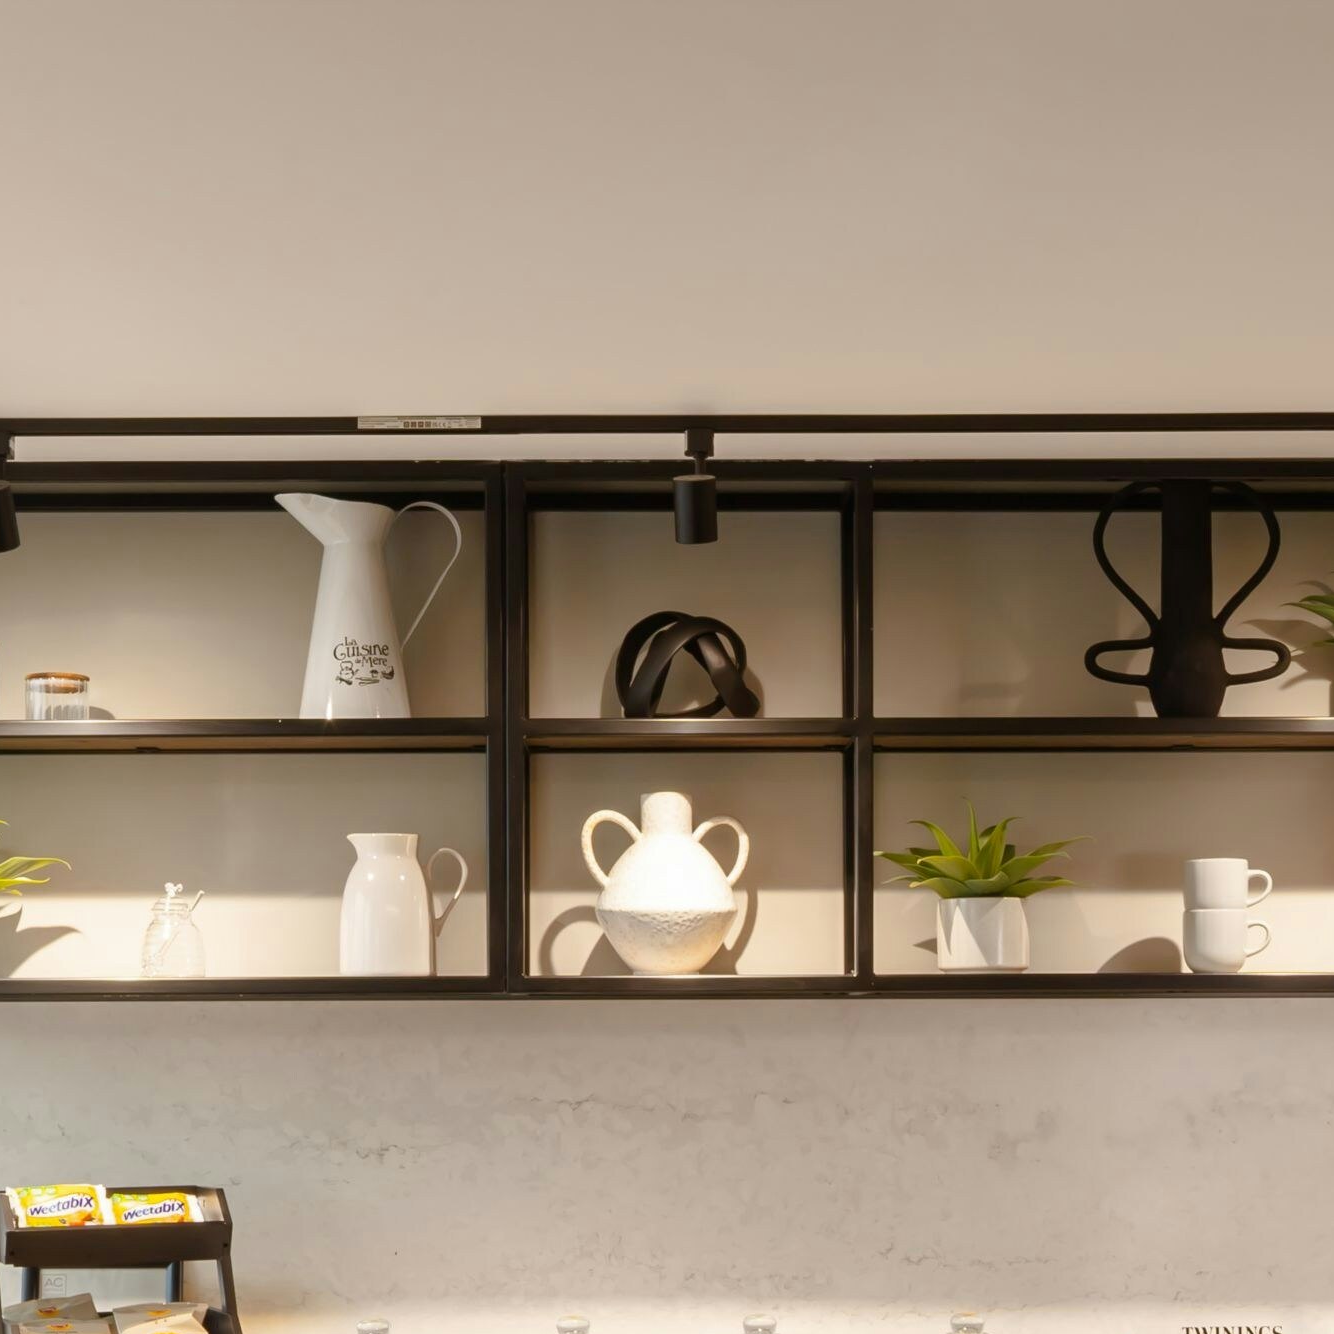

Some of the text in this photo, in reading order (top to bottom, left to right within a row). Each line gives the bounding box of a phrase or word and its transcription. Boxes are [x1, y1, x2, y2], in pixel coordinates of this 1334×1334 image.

[344, 636, 357, 646] La
[333, 644, 389, 661] Cuisine
[29, 1196, 94, 1216] Weetabix
[123, 1202, 185, 1221] Weetabix
